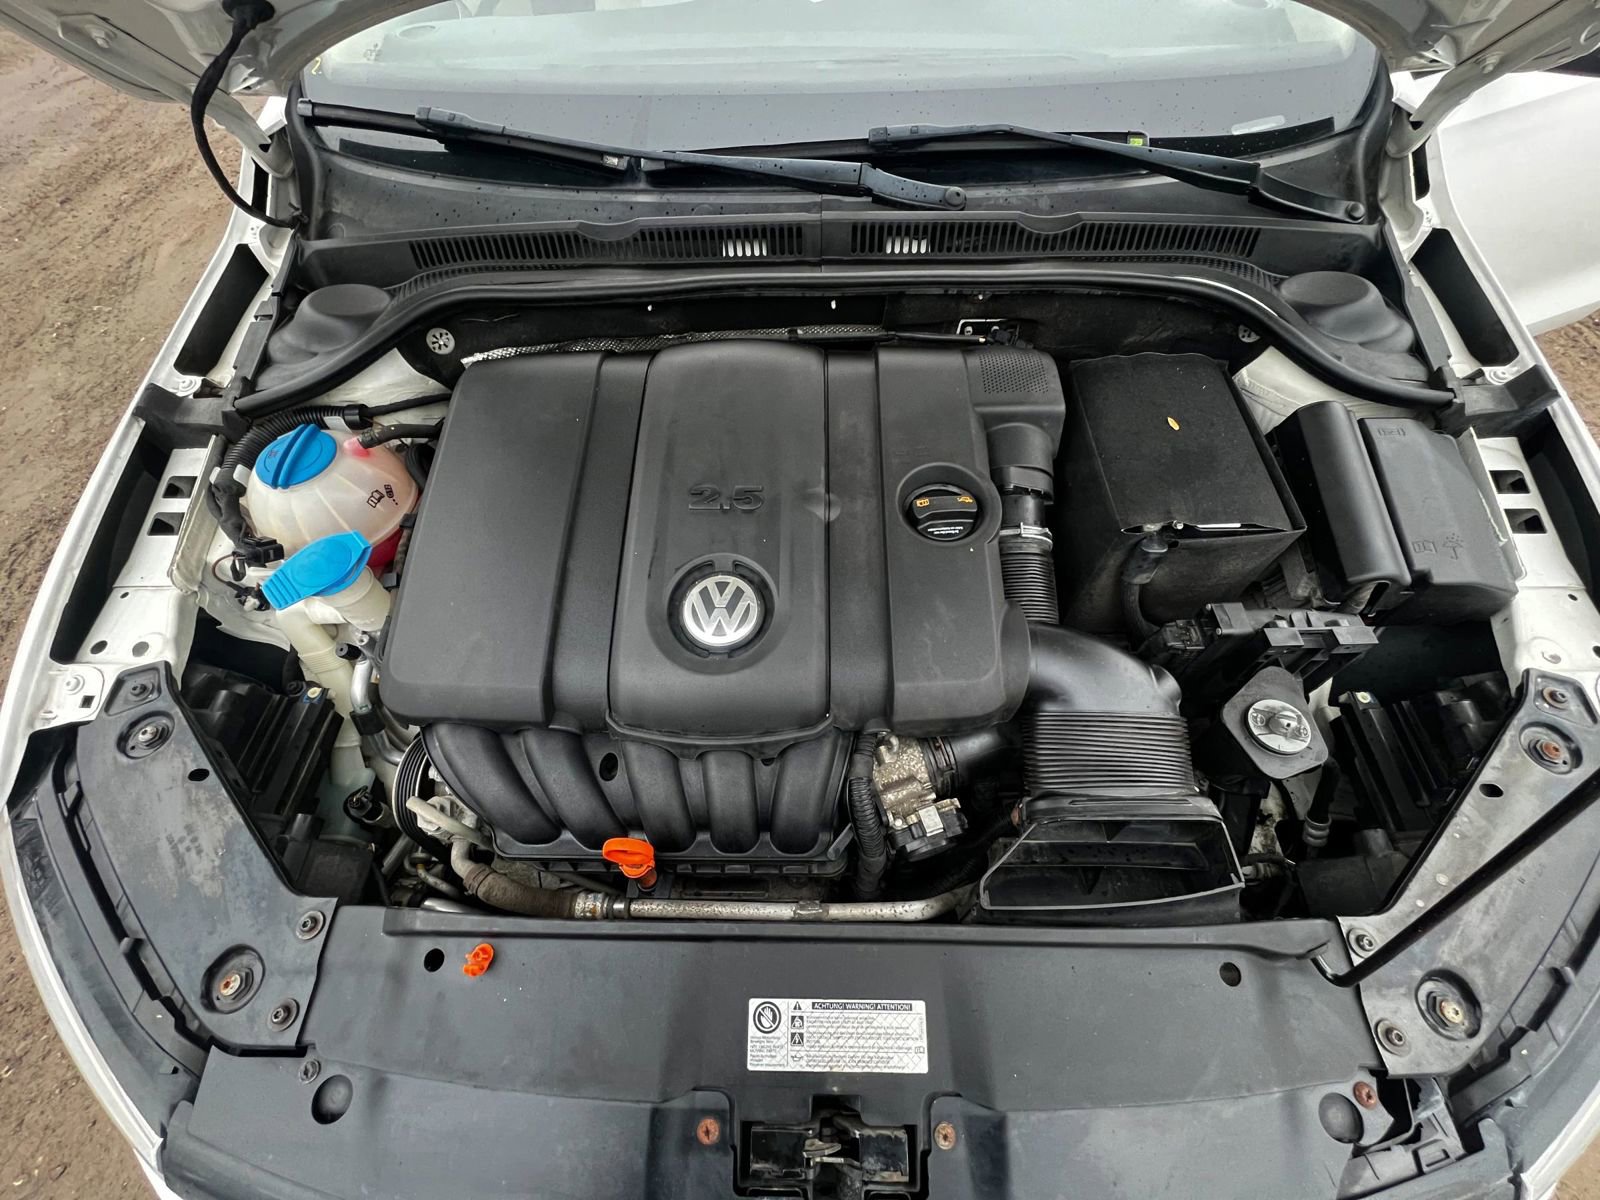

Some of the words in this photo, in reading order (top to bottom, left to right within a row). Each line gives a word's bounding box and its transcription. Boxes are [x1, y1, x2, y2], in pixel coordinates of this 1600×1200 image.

[688, 484, 765, 511] 2.5
[684, 575, 758, 646] VW
[813, 1002, 845, 1010] ACHTUNG!
[876, 1003, 911, 1011] ATTENTION!
